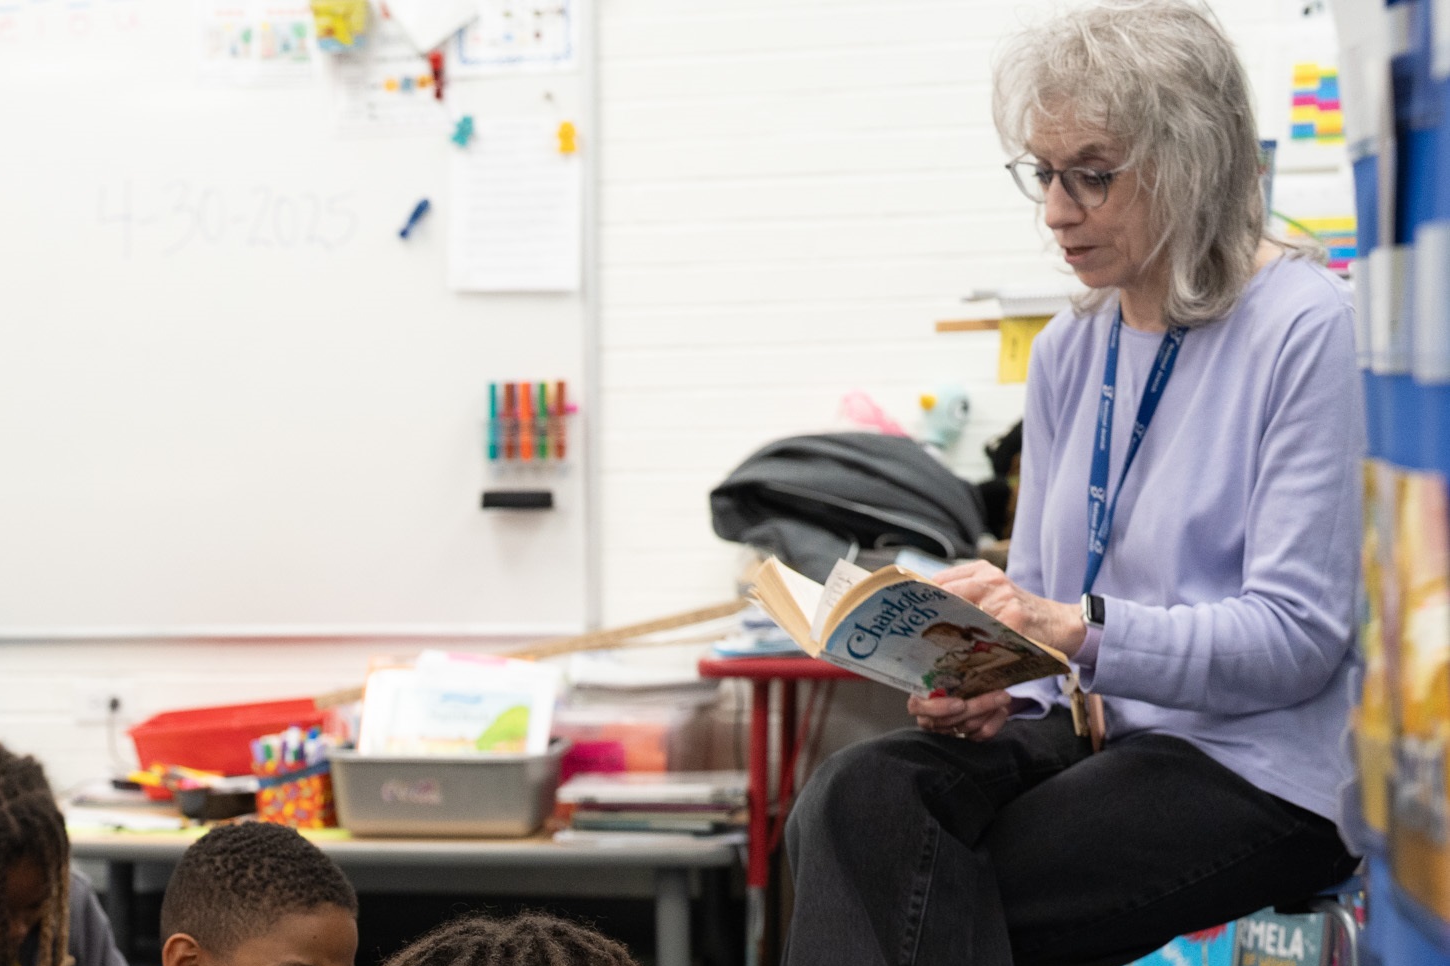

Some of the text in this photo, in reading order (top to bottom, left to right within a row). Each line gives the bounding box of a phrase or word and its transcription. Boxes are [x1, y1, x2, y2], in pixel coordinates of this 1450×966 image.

[95, 176, 360, 260] 4-30-2025
[846, 588, 948, 660] Charlotte's
[887, 606, 939, 639] Web
